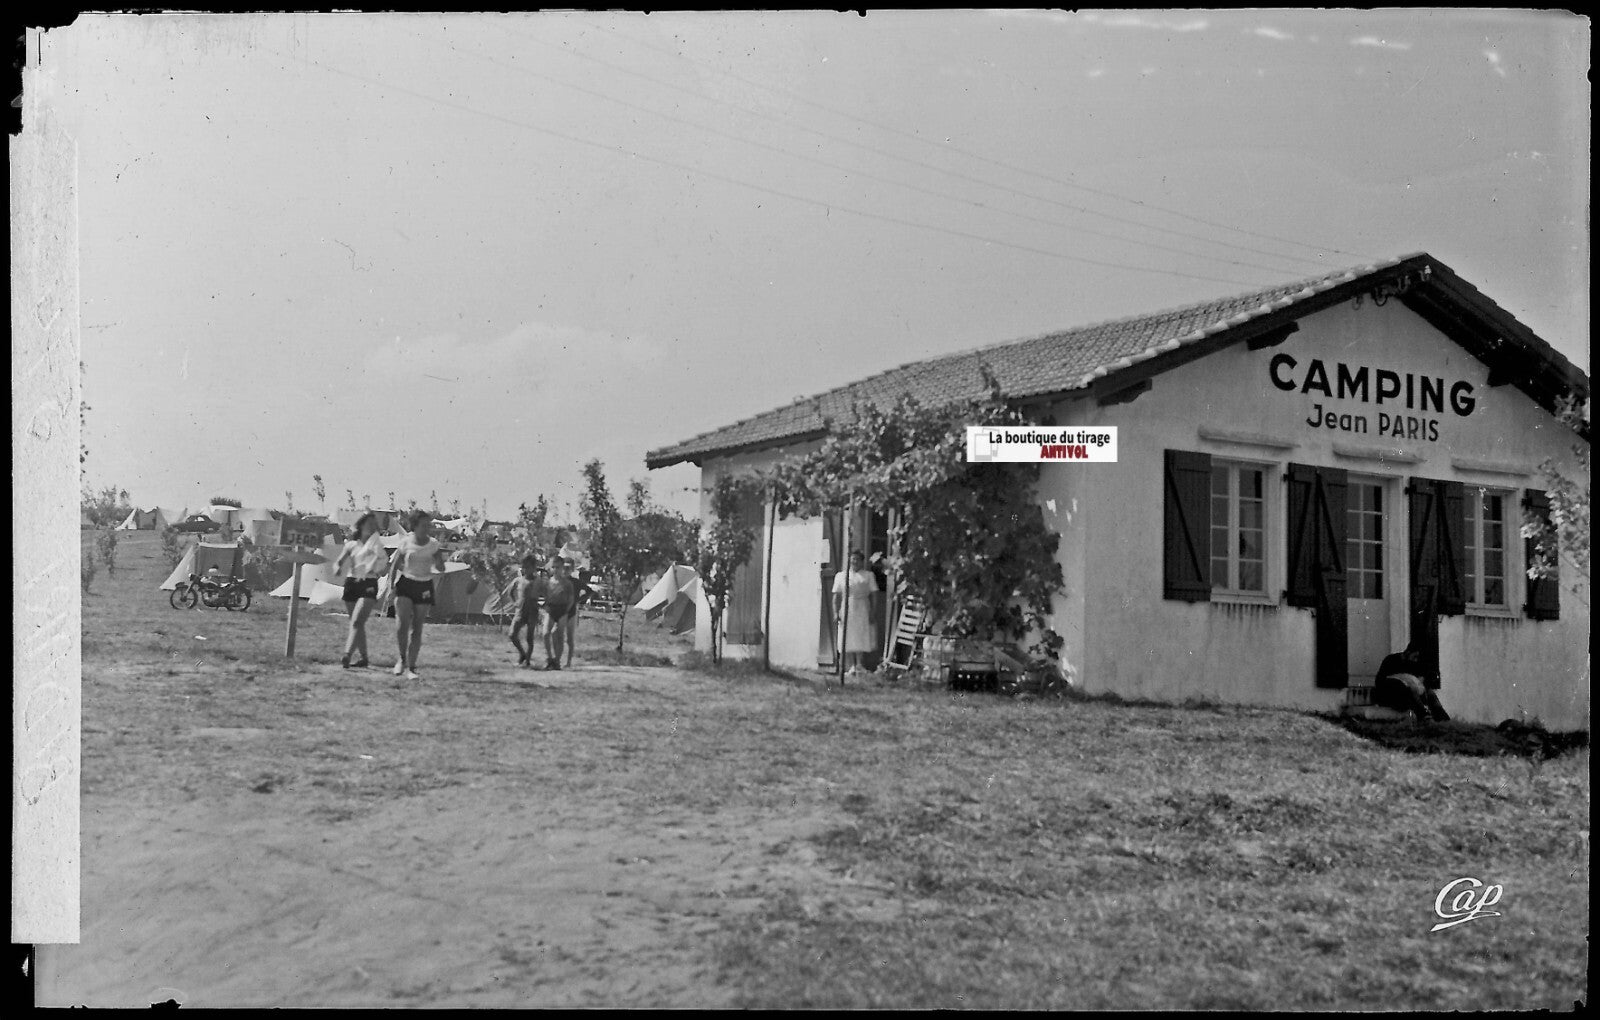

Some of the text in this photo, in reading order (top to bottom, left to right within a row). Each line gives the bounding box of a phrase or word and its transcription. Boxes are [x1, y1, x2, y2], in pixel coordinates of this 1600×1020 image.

[1269, 353, 1476, 417] CAMPING
[1306, 404, 1439, 442] Jean PARIS
